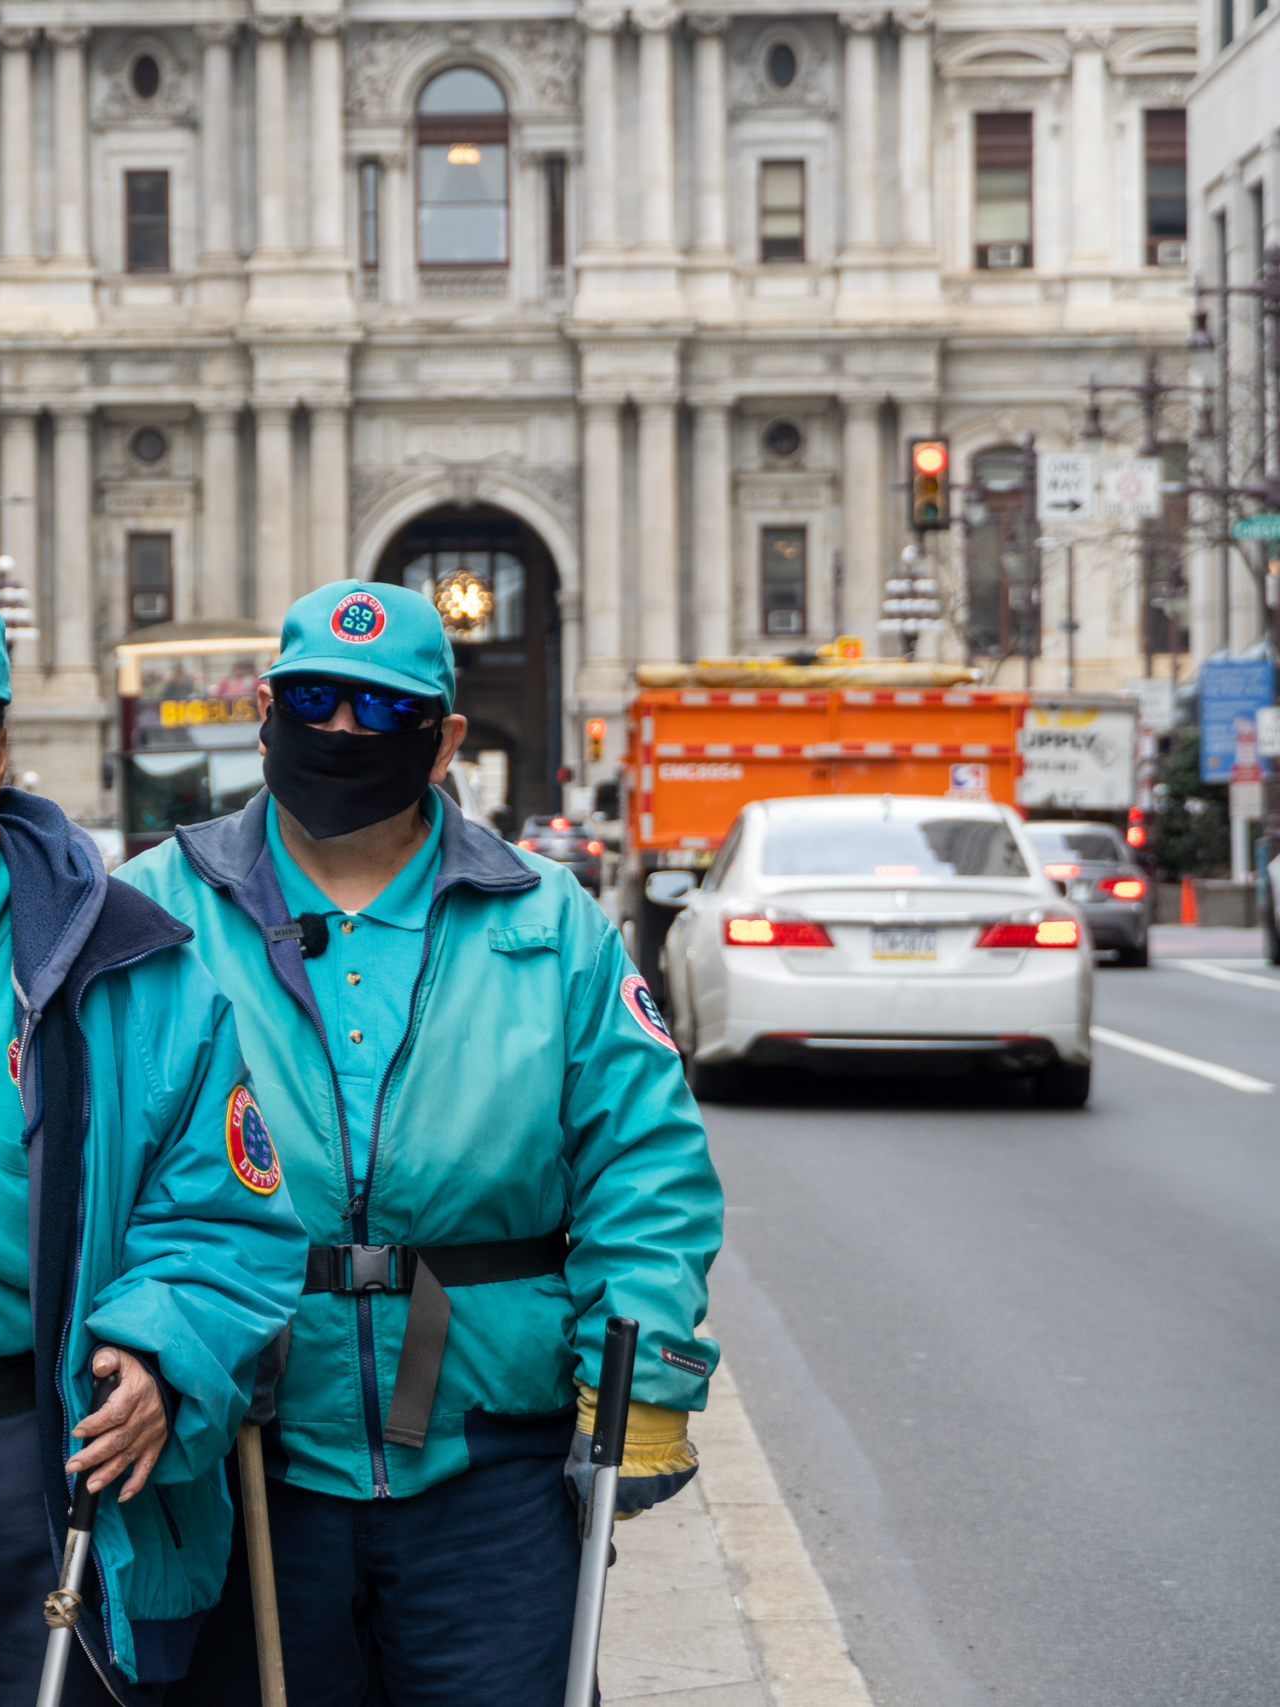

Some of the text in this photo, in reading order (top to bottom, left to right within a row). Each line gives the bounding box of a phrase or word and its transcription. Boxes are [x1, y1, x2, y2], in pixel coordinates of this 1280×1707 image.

[1047, 459, 1084, 472] ONE
[1047, 478, 1081, 491] WAY
[338, 594, 384, 614] CENTER CITY
[336, 629, 373, 641] DISTRICT
[1023, 732, 1098, 751] UPPLY
[239, 1157, 279, 1187] DISTRICT
